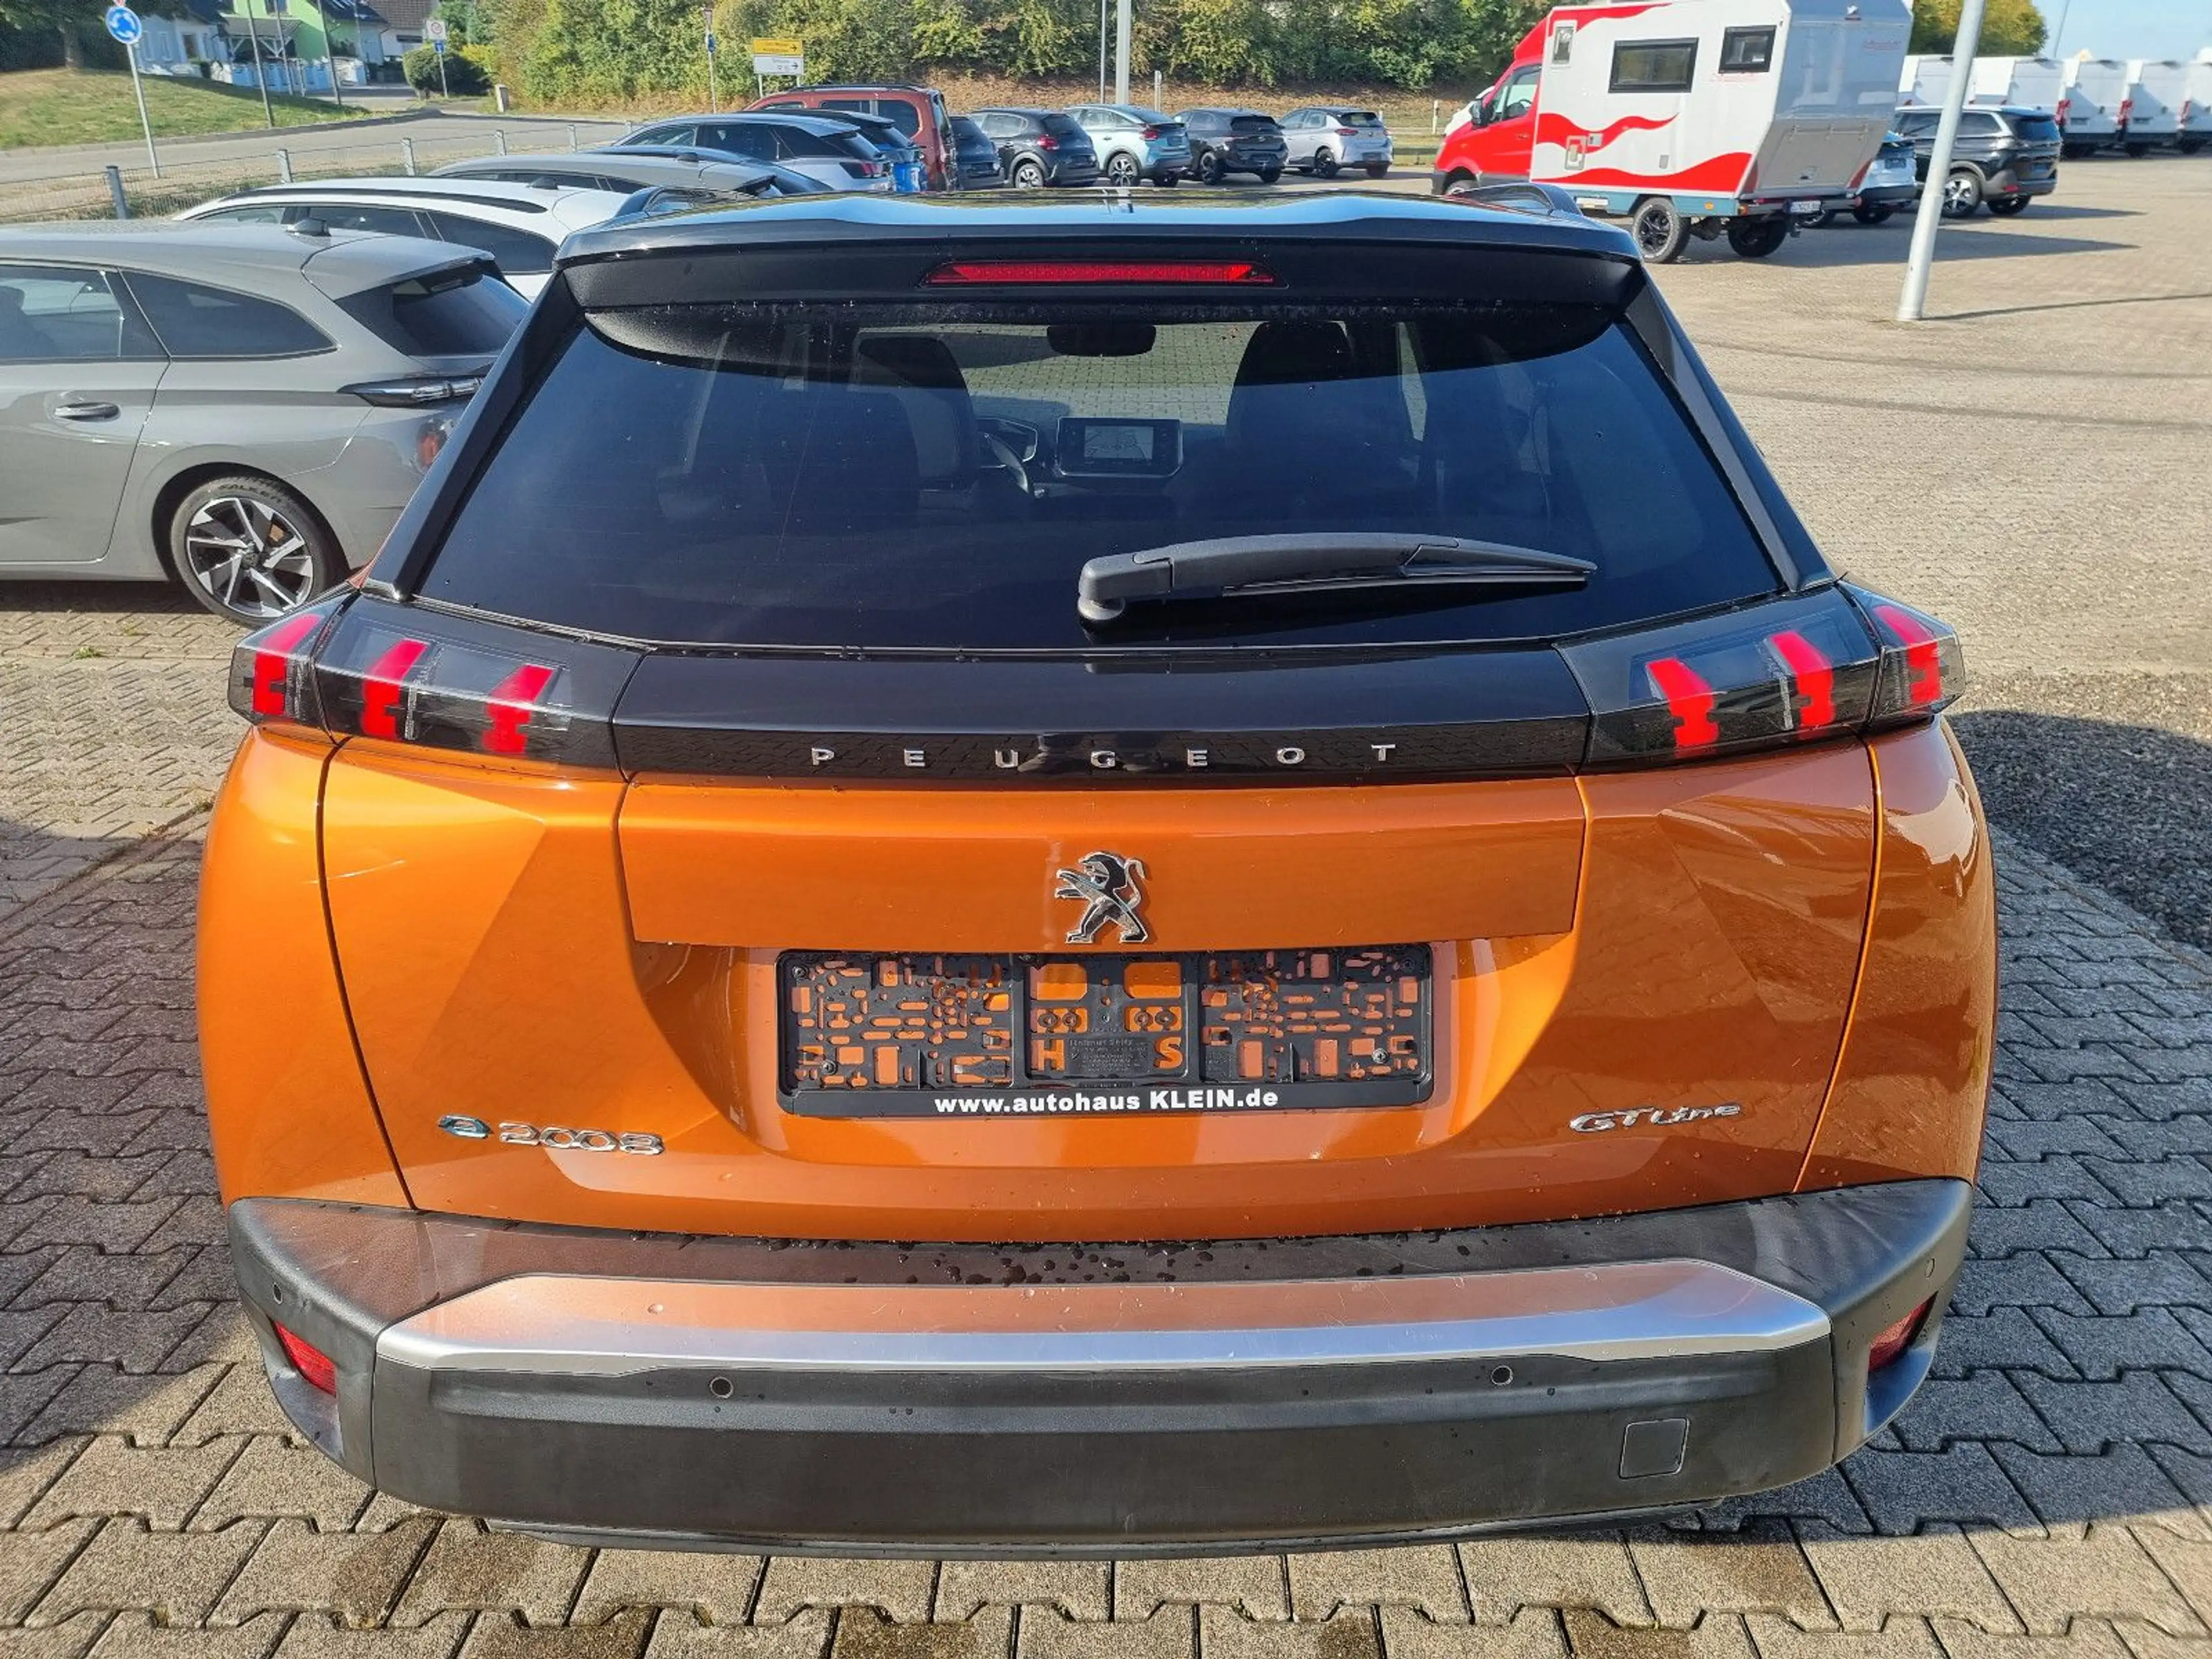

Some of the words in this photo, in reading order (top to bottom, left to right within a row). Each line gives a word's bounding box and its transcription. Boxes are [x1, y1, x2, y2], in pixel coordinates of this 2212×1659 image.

[811, 744, 1396, 768] PEUGEOT
[934, 1092, 1141, 1112] www.autohaus
[1150, 1088, 1279, 1109] KLEIN.de
